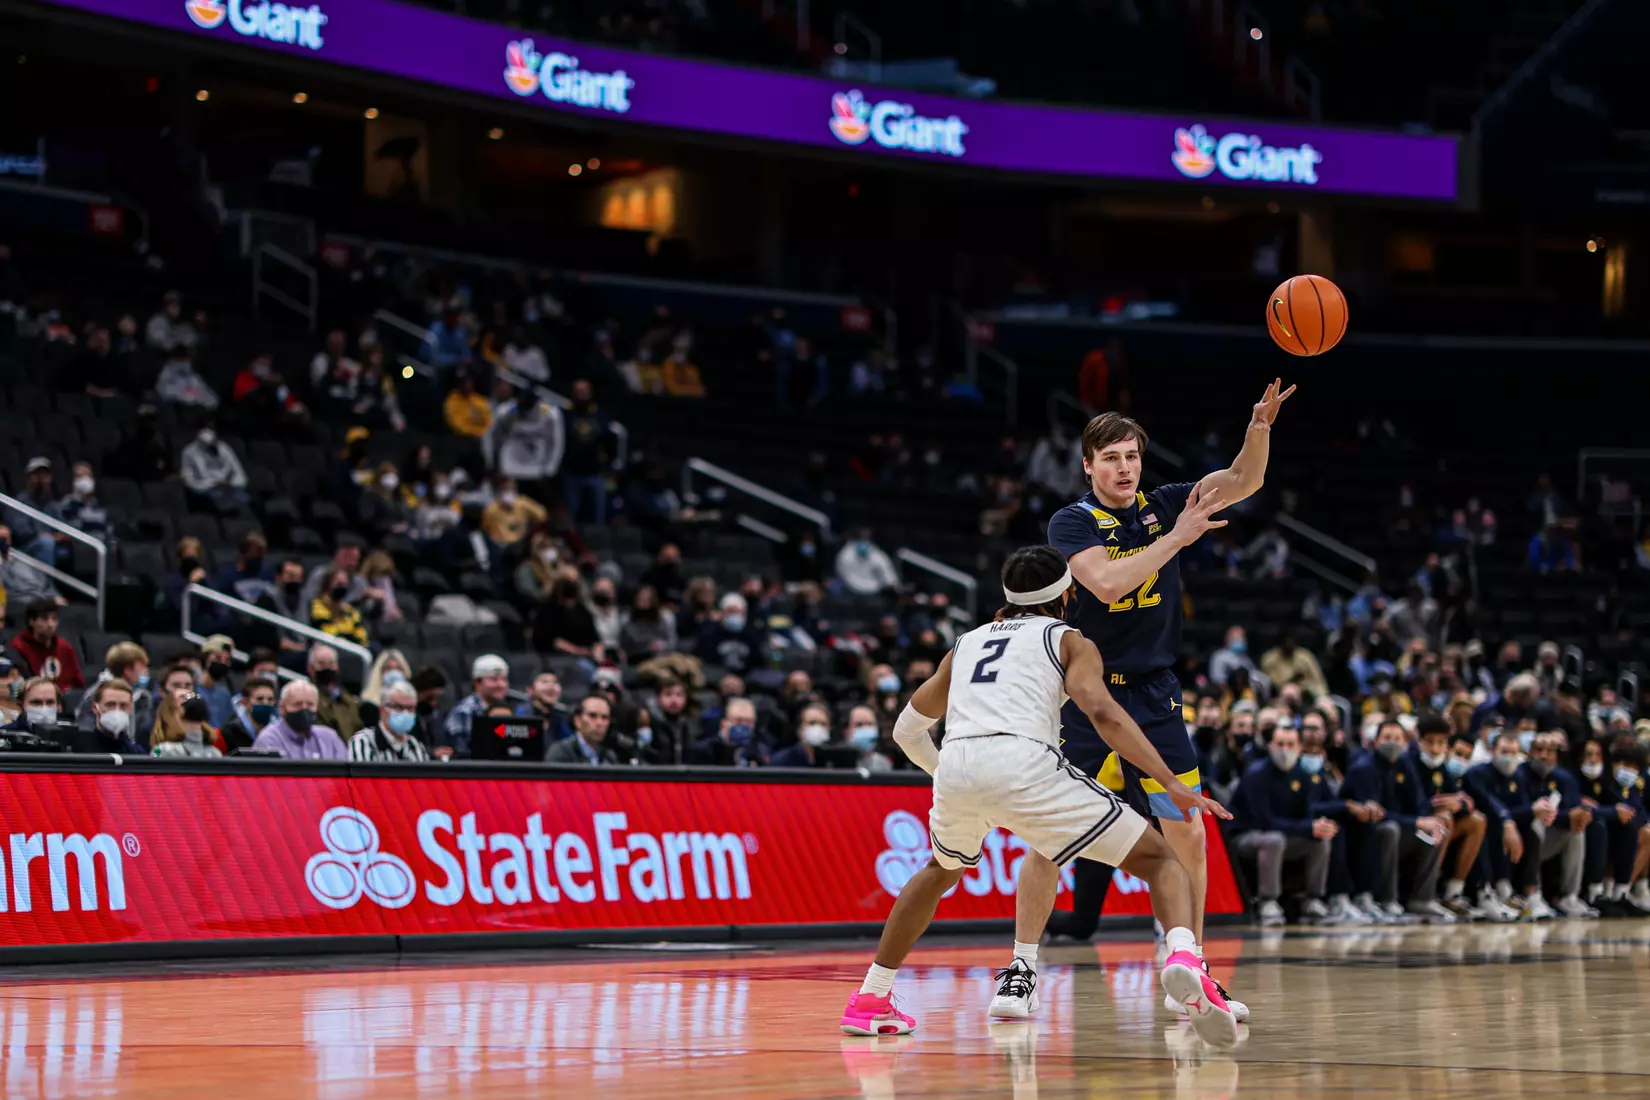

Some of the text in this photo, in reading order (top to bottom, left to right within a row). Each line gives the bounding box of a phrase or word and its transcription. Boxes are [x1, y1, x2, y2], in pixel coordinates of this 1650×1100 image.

[228, 0, 328, 50] Giant
[541, 52, 635, 113] Giant
[870, 100, 969, 157] Giant
[1217, 132, 1323, 184] Giant
[969, 637, 1011, 683] 2
